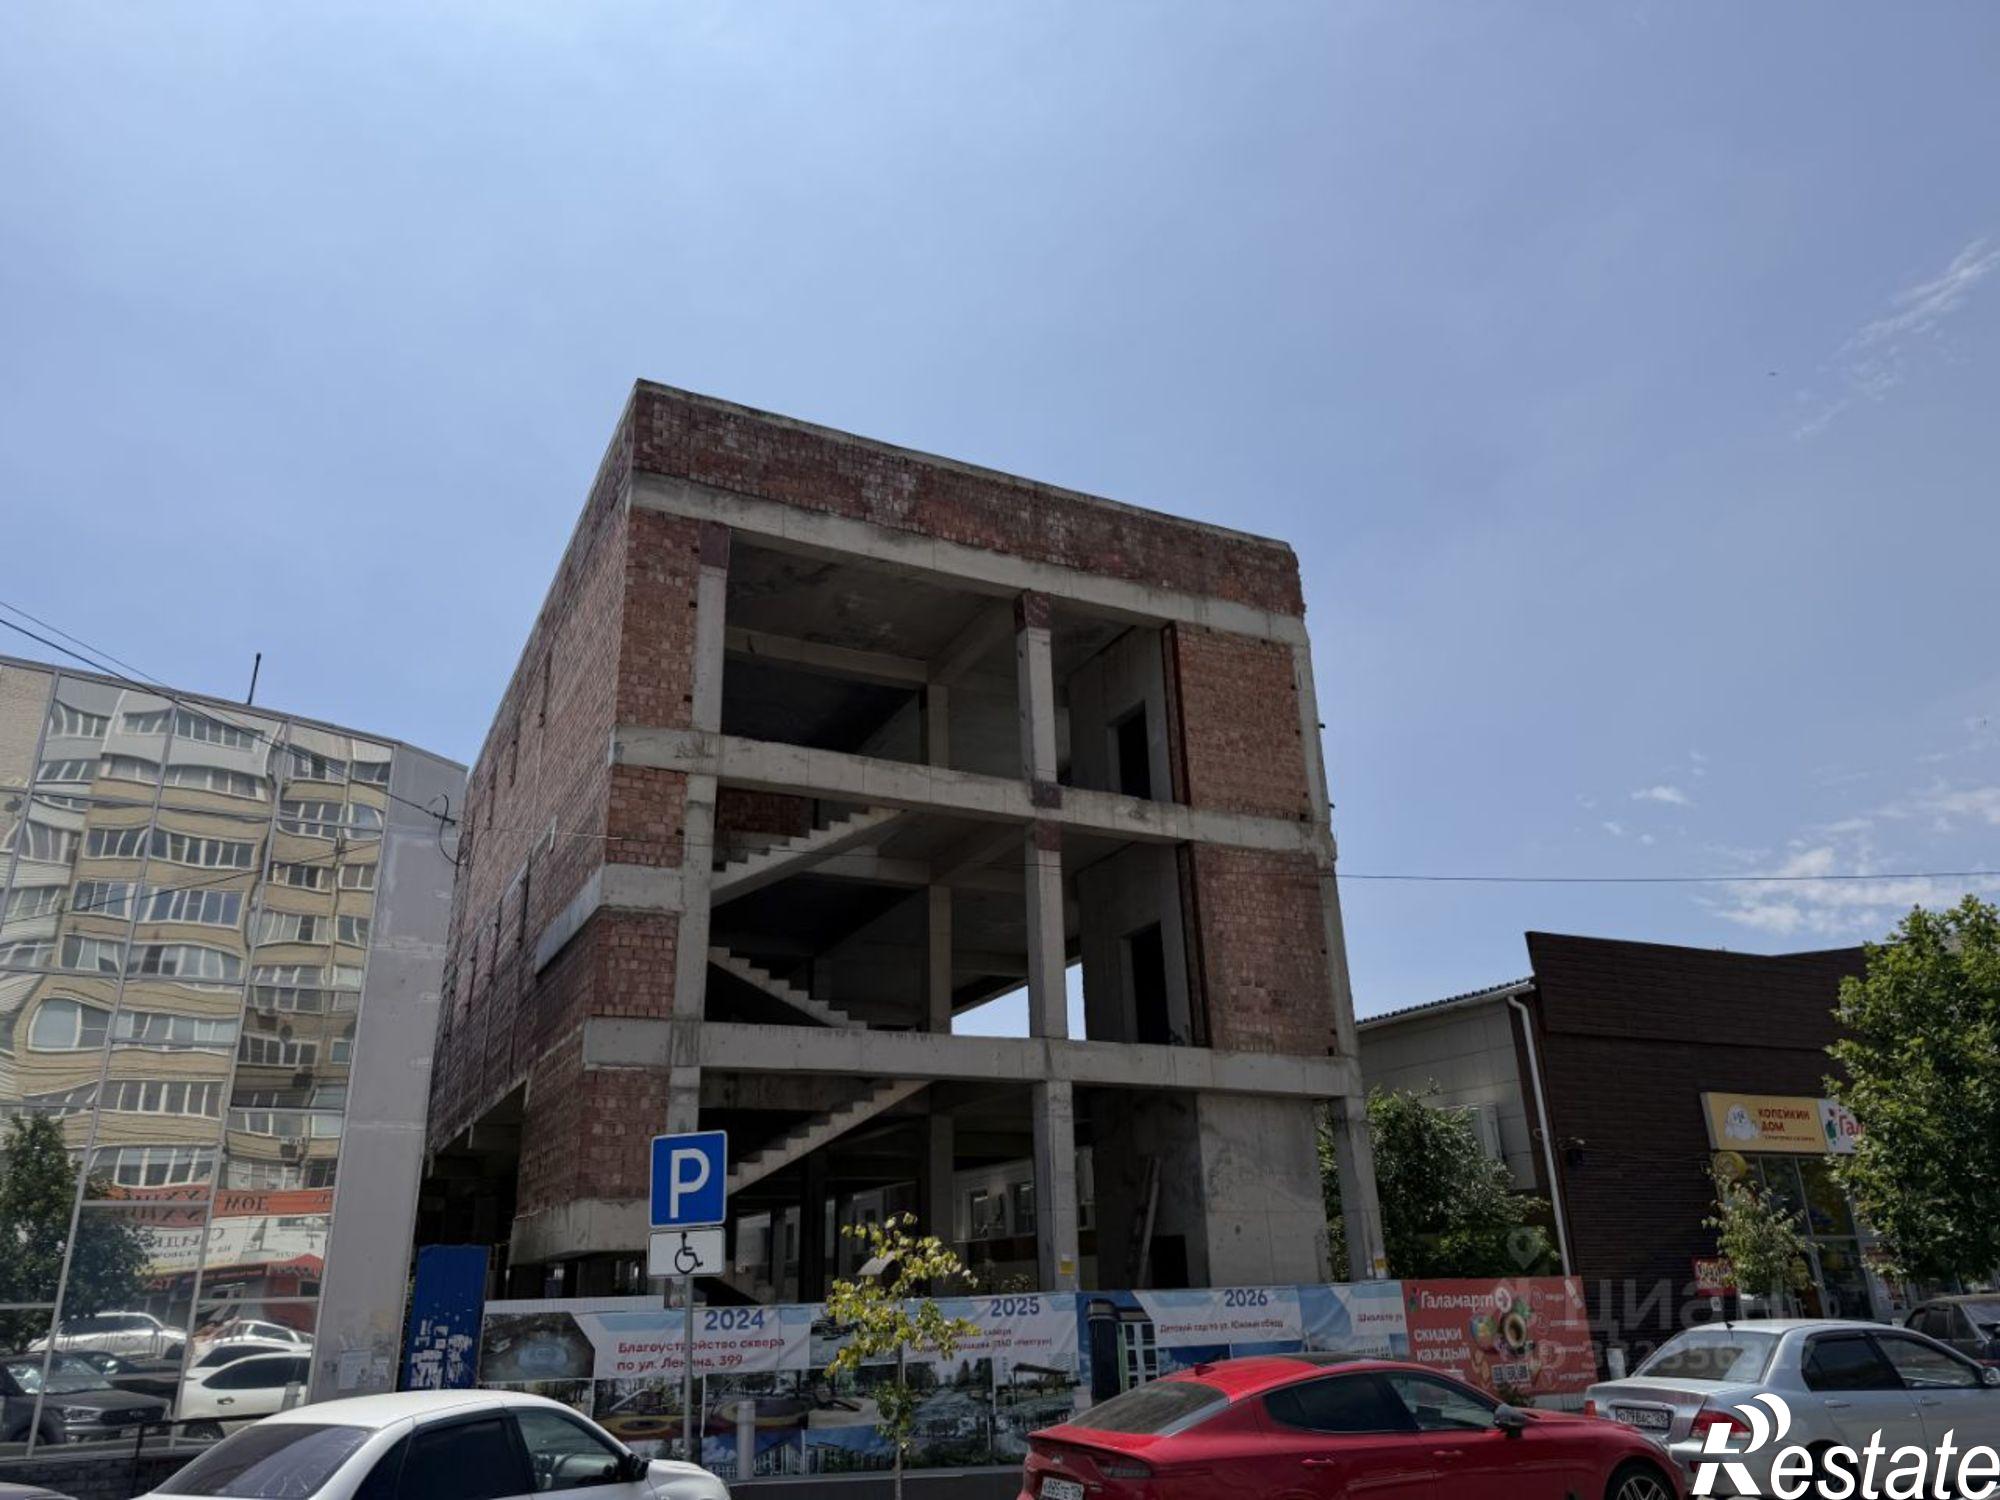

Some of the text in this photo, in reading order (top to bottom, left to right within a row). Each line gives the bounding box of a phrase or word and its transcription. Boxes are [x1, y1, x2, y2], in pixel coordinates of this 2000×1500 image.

[1761, 1120, 1785, 1132] ДОМ
[1839, 1114, 1865, 1137] Гал
[670, 1148, 710, 1219] P
[990, 1297, 1040, 1317] 2025
[1224, 1289, 1268, 1307] 2026
[704, 1308, 765, 1331] 2024
[740, 1337, 785, 1349] сквера
[1414, 1328, 1462, 1344] скидки
[1417, 1343, 1471, 1363] каждый
[617, 1361, 634, 1371] по
[638, 1360, 655, 1373] ул.
[719, 1355, 743, 1367] 399
